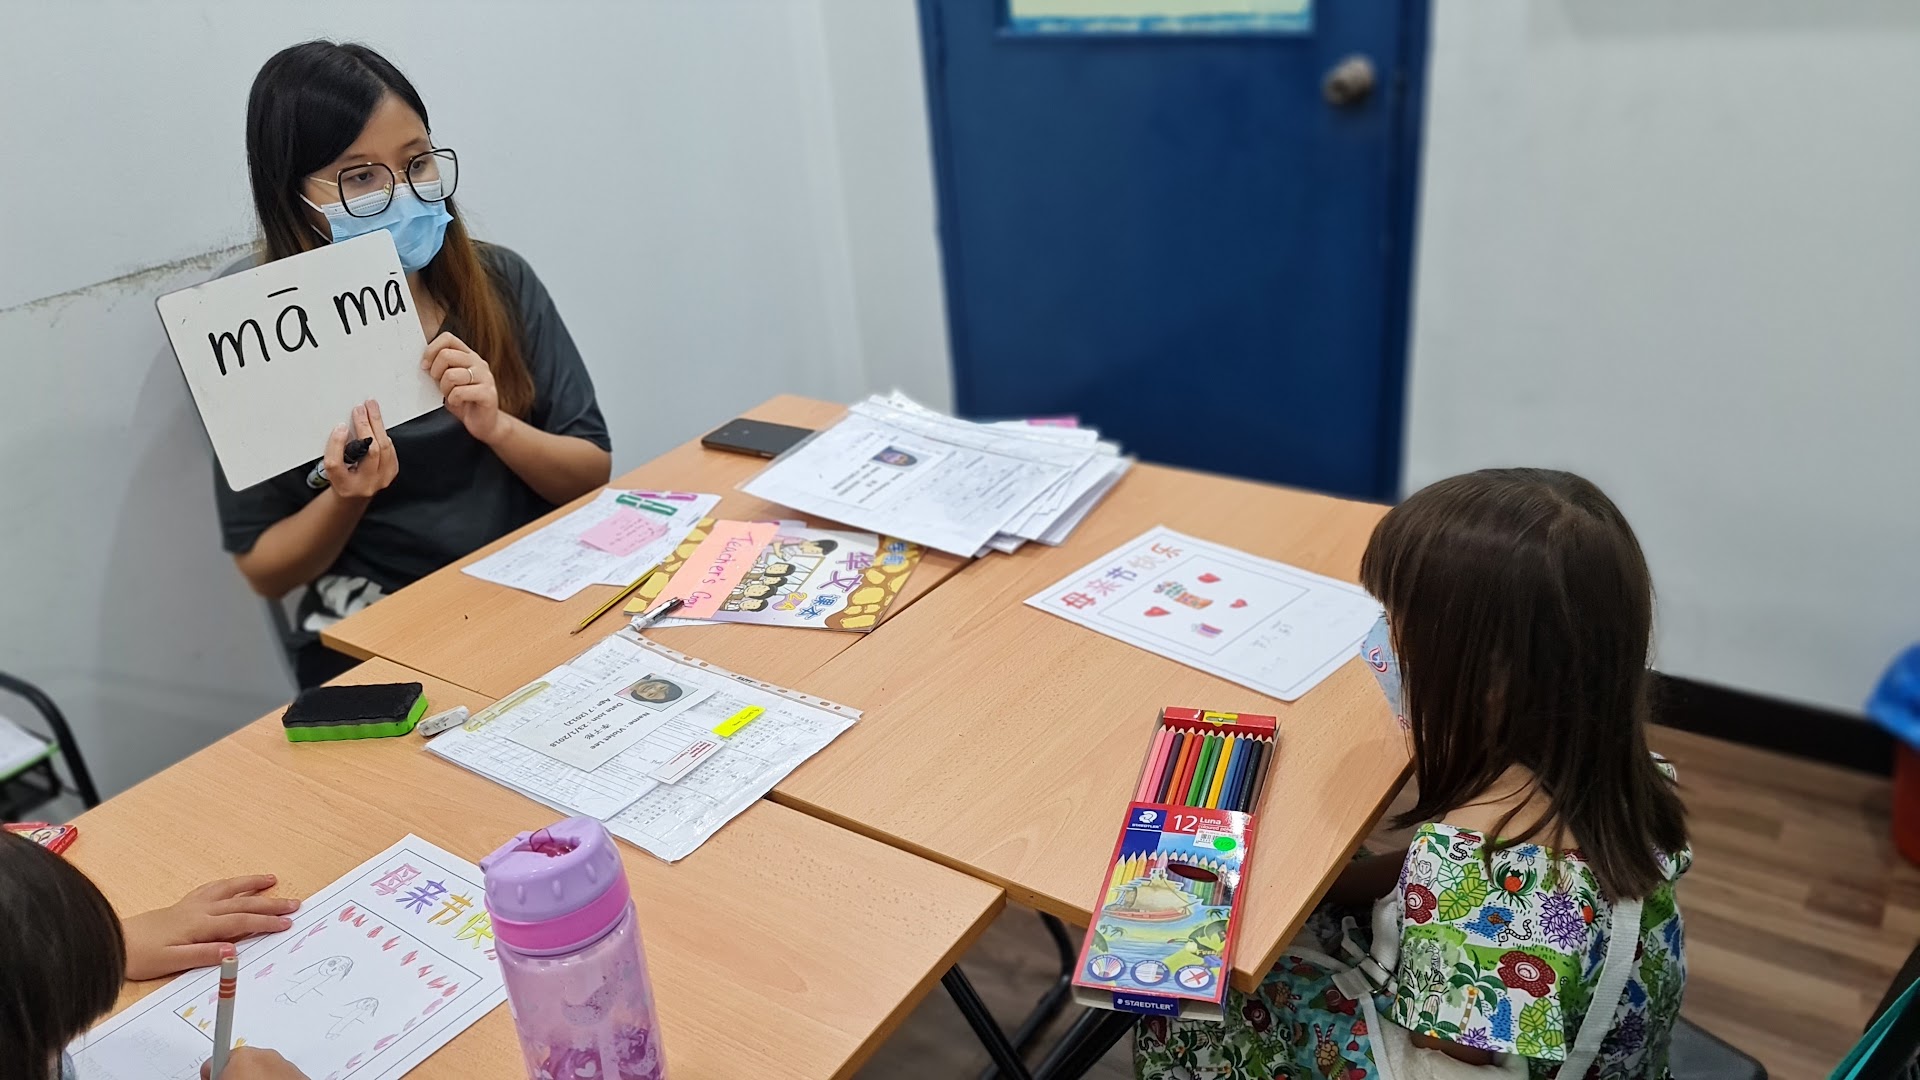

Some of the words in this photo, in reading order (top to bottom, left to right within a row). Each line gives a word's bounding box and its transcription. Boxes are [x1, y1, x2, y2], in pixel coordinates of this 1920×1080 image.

[208, 287, 319, 376] mā
[702, 532, 754, 584] Teacher's
[818, 551, 876, 593] 华文
[781, 592, 808, 611] 2A
[796, 595, 840, 619] 课本
[628, 712, 651, 726] Name
[1174, 814, 1198, 832] 12
[1199, 817, 1222, 825] Luna
[1125, 999, 1172, 1010] STAEDTLER
